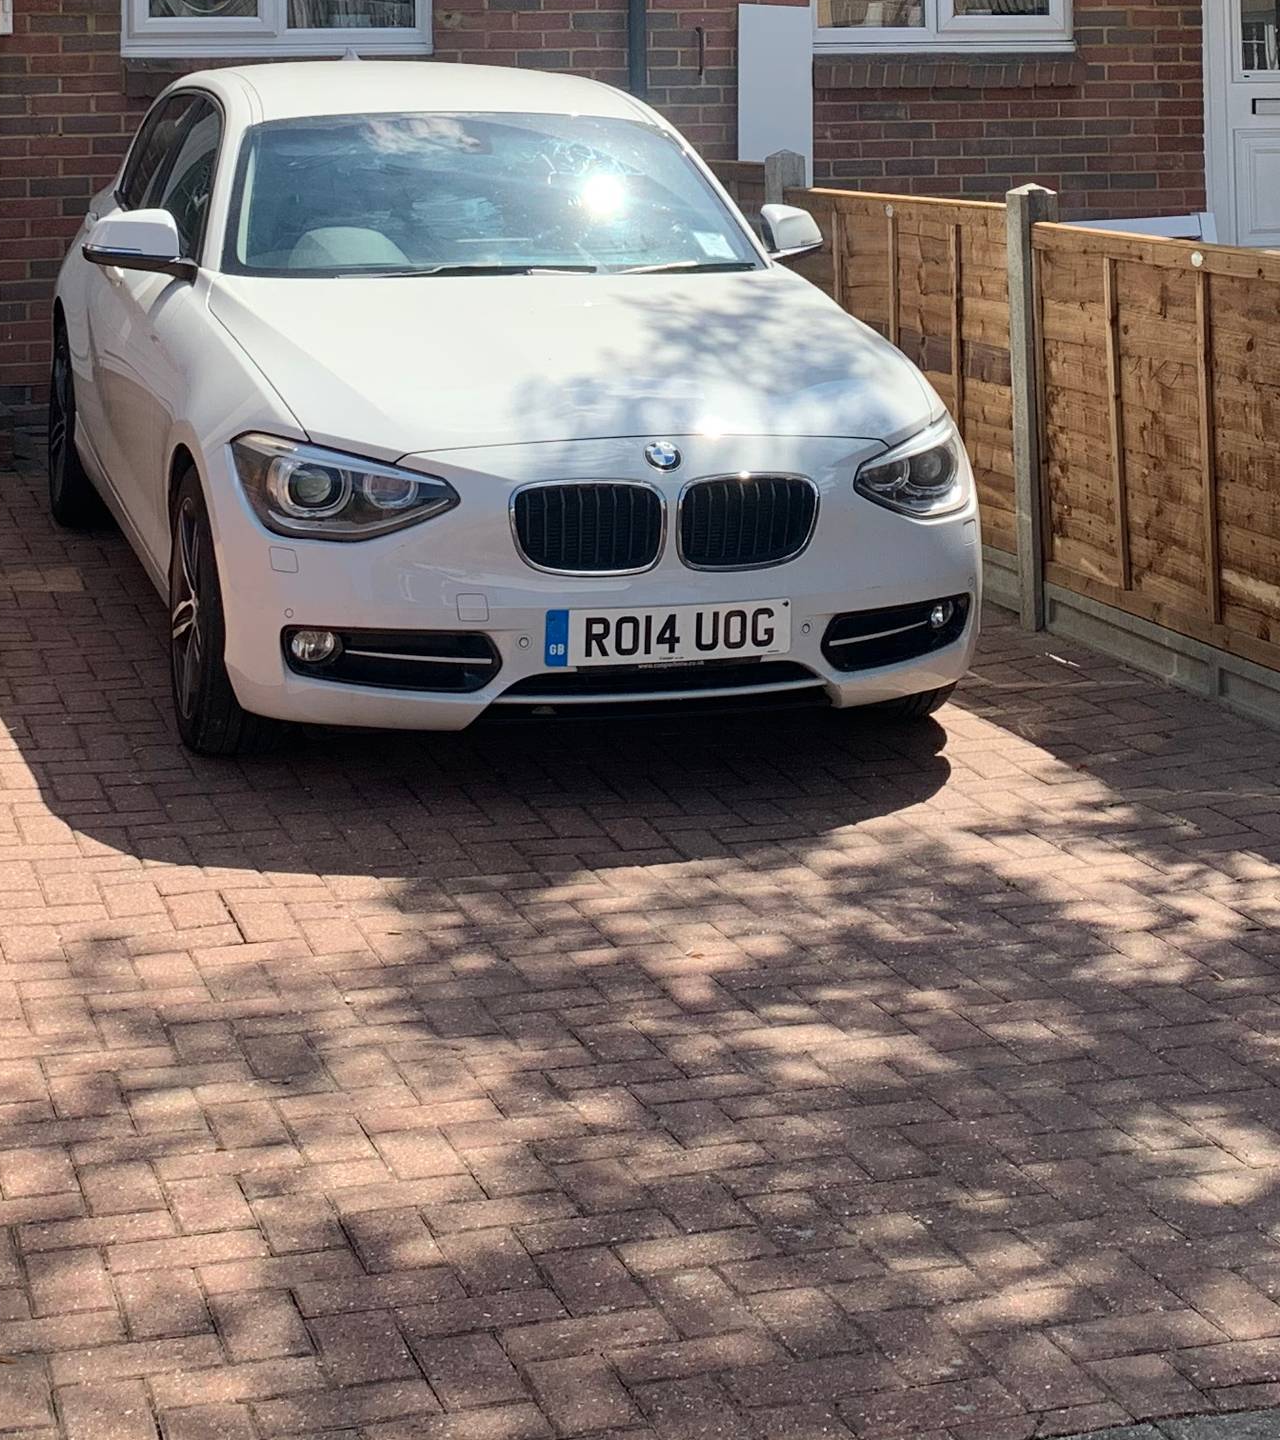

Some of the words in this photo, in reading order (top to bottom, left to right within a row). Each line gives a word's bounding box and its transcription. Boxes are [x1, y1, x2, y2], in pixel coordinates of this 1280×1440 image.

[585, 613, 680, 657] RO14
[695, 607, 775, 652] UOG
[549, 643, 565, 655] GB
